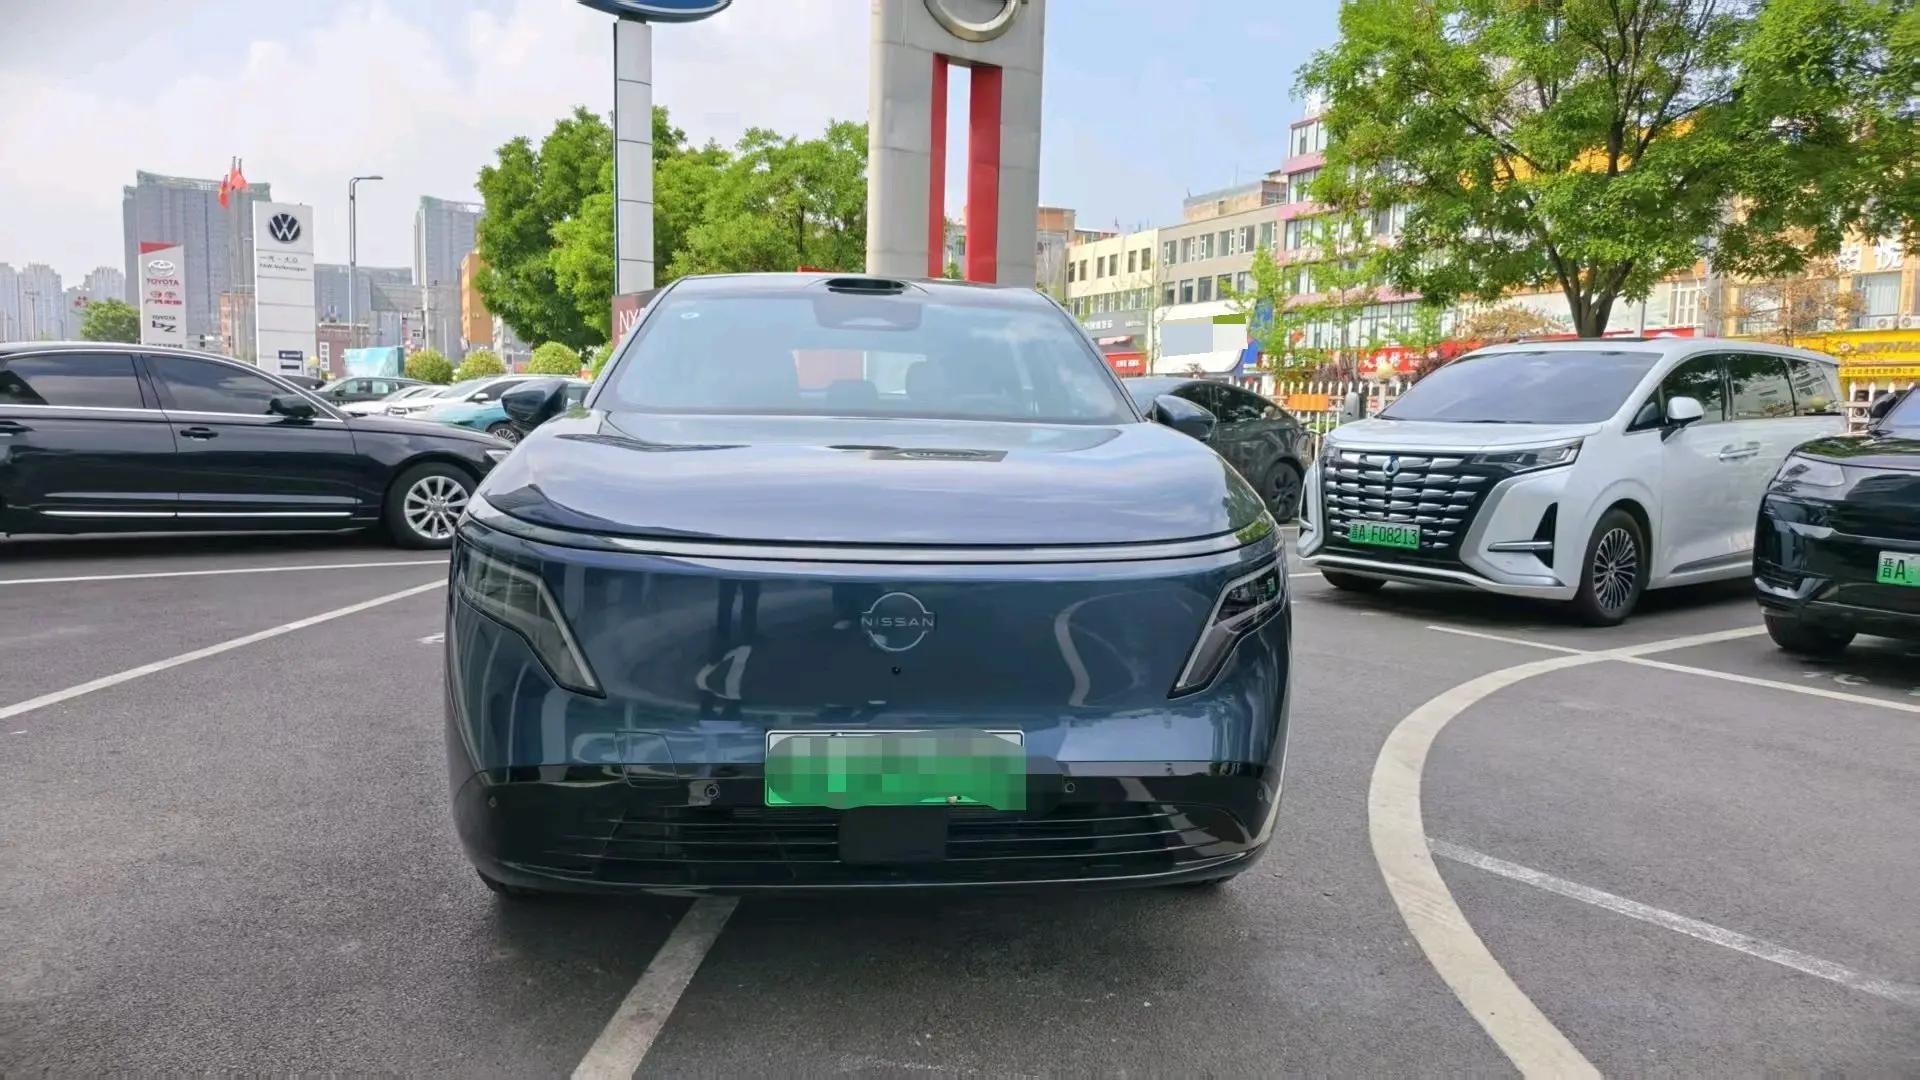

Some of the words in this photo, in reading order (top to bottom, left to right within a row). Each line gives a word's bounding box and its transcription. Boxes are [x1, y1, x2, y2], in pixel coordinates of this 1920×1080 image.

[269, 212, 301, 242] VW
[146, 278, 180, 286] TOYOTA
[861, 616, 934, 627] NISSAN
